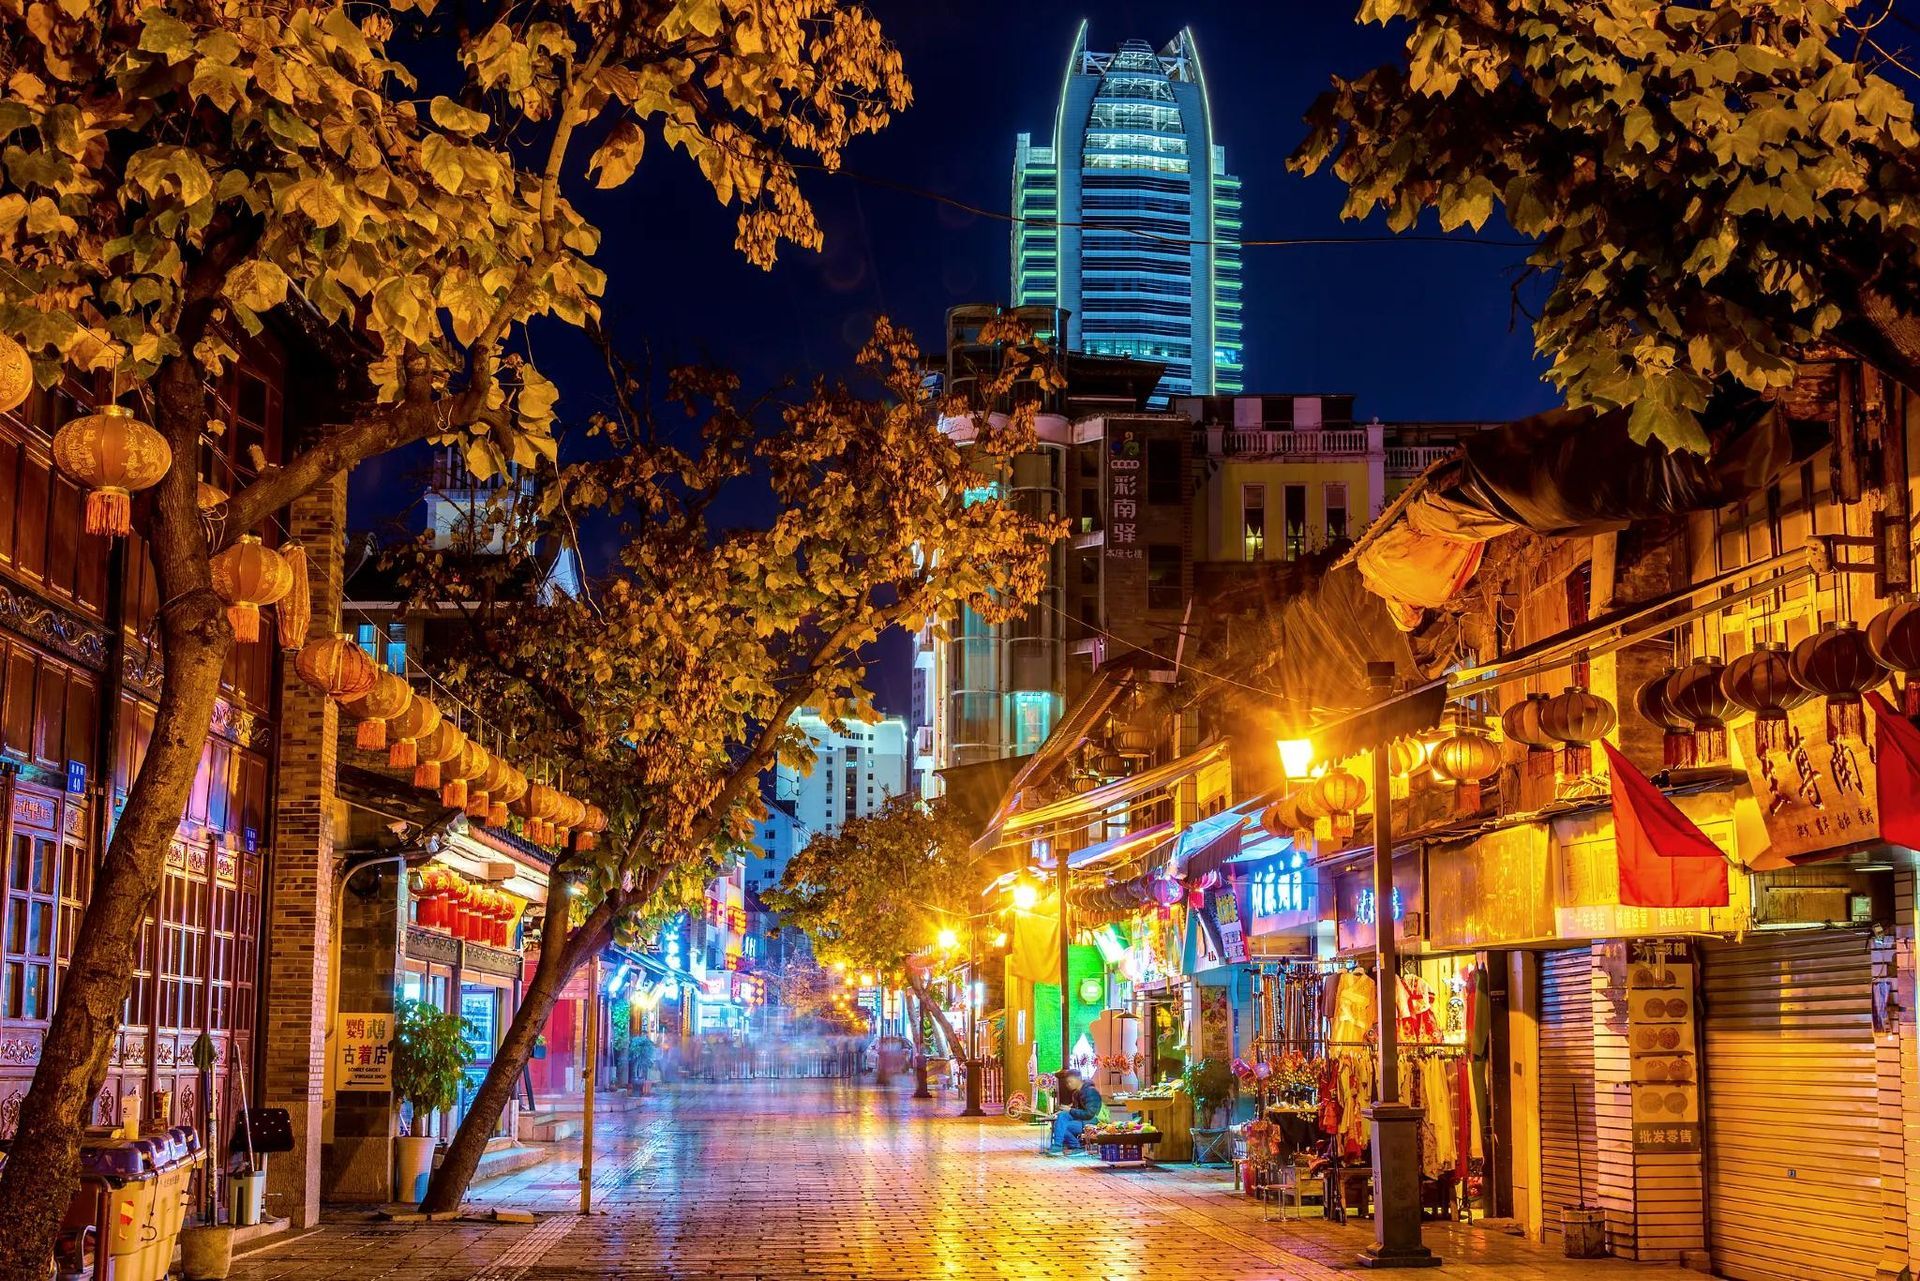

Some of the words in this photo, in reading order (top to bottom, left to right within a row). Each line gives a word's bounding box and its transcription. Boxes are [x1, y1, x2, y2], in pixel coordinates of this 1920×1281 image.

[1114, 475, 1137, 543] 彩南驿
[73, 777, 81, 792] 40
[343, 1045, 387, 1064] 古着店
[1639, 1129, 1692, 1144] 批发零售
